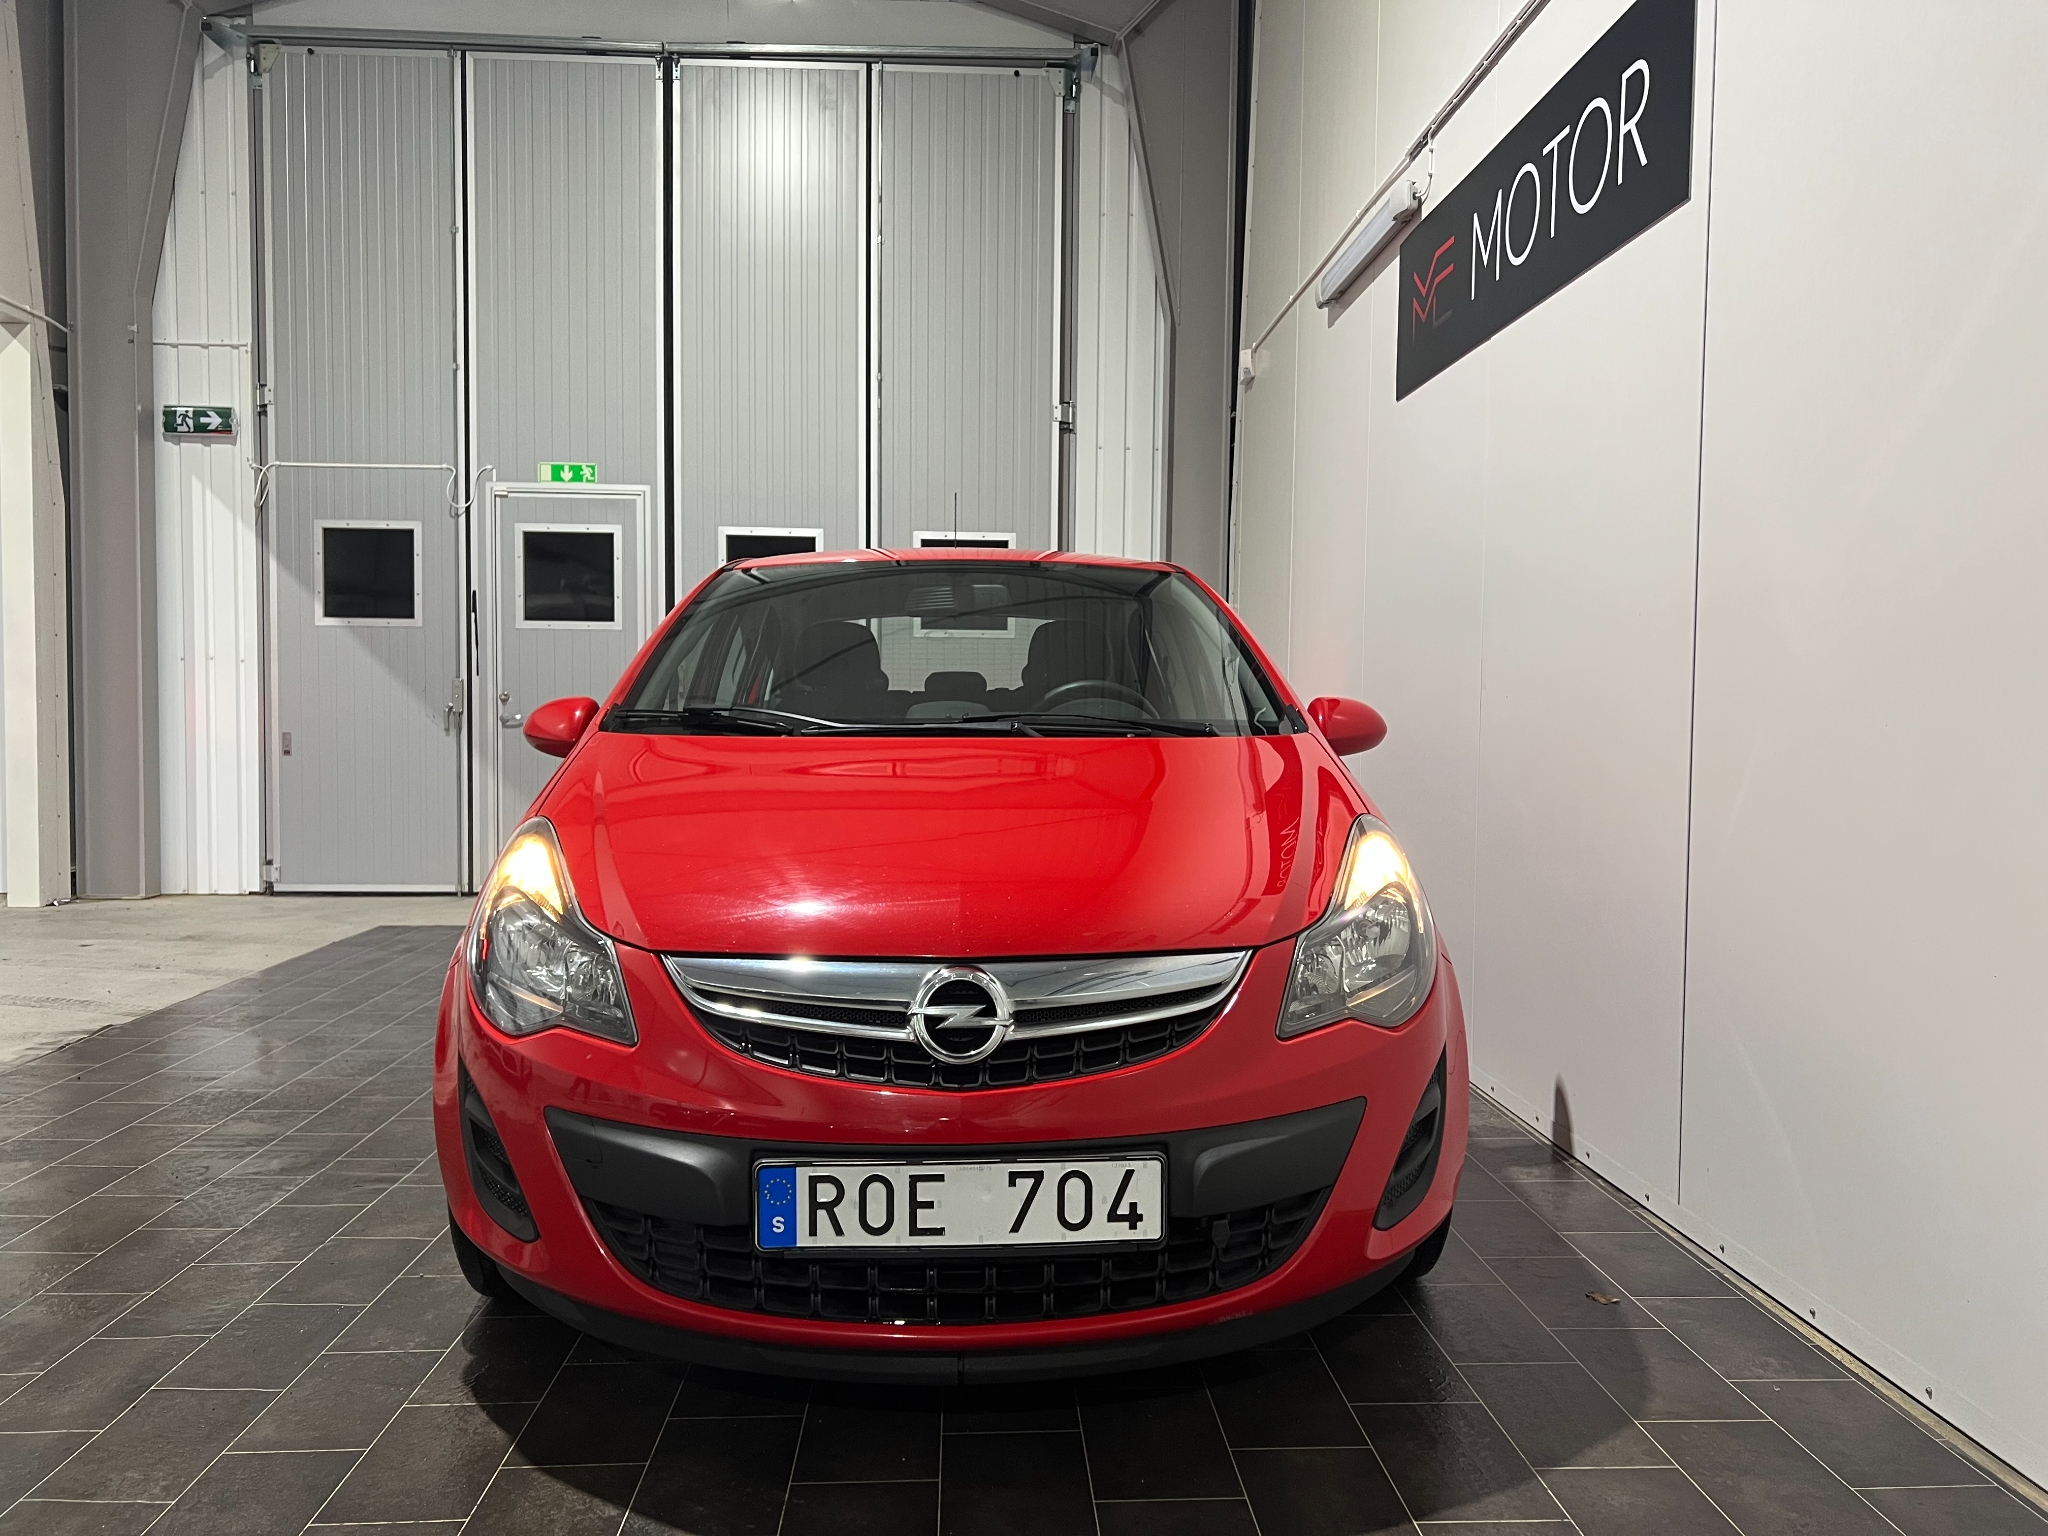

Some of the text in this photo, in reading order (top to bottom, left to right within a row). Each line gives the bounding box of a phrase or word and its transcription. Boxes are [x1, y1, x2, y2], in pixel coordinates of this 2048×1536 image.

[1471, 58, 1650, 300] MOTOR
[771, 1216, 786, 1234] S
[808, 1168, 1144, 1237] ROE 704
